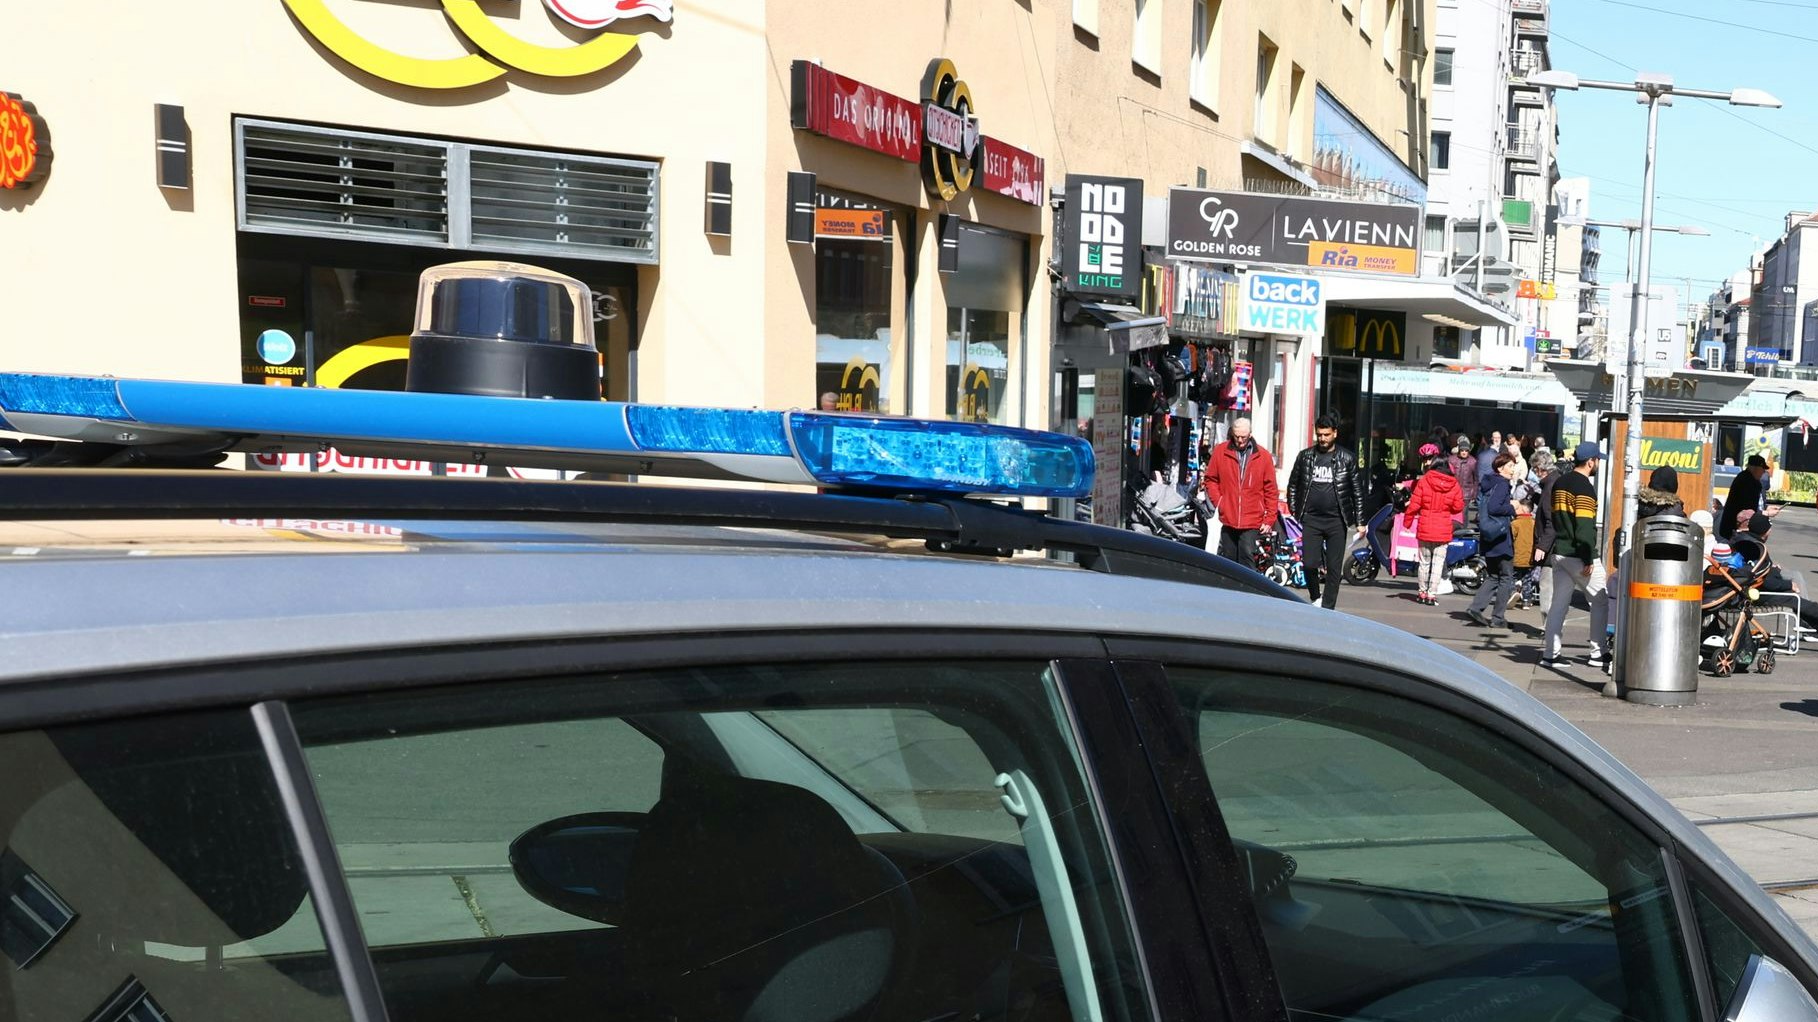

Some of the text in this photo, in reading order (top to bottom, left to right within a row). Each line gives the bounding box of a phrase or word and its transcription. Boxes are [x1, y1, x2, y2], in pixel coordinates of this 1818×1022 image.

[833, 93, 857, 124] DAS
[989, 152, 1008, 179] SEIT
[1284, 215, 1414, 247] LAVIENN
[1174, 239, 1261, 257] GOLDEN ROSE
[1321, 246, 1396, 267] Ria MONEY
[1543, 234, 1556, 285] HUMANIC
[1079, 274, 1122, 288] KING
[1252, 274, 1320, 305] back
[1248, 303, 1319, 332] WERK
[1756, 349, 1780, 360] Tchib
[1640, 438, 1701, 469] Maroni
